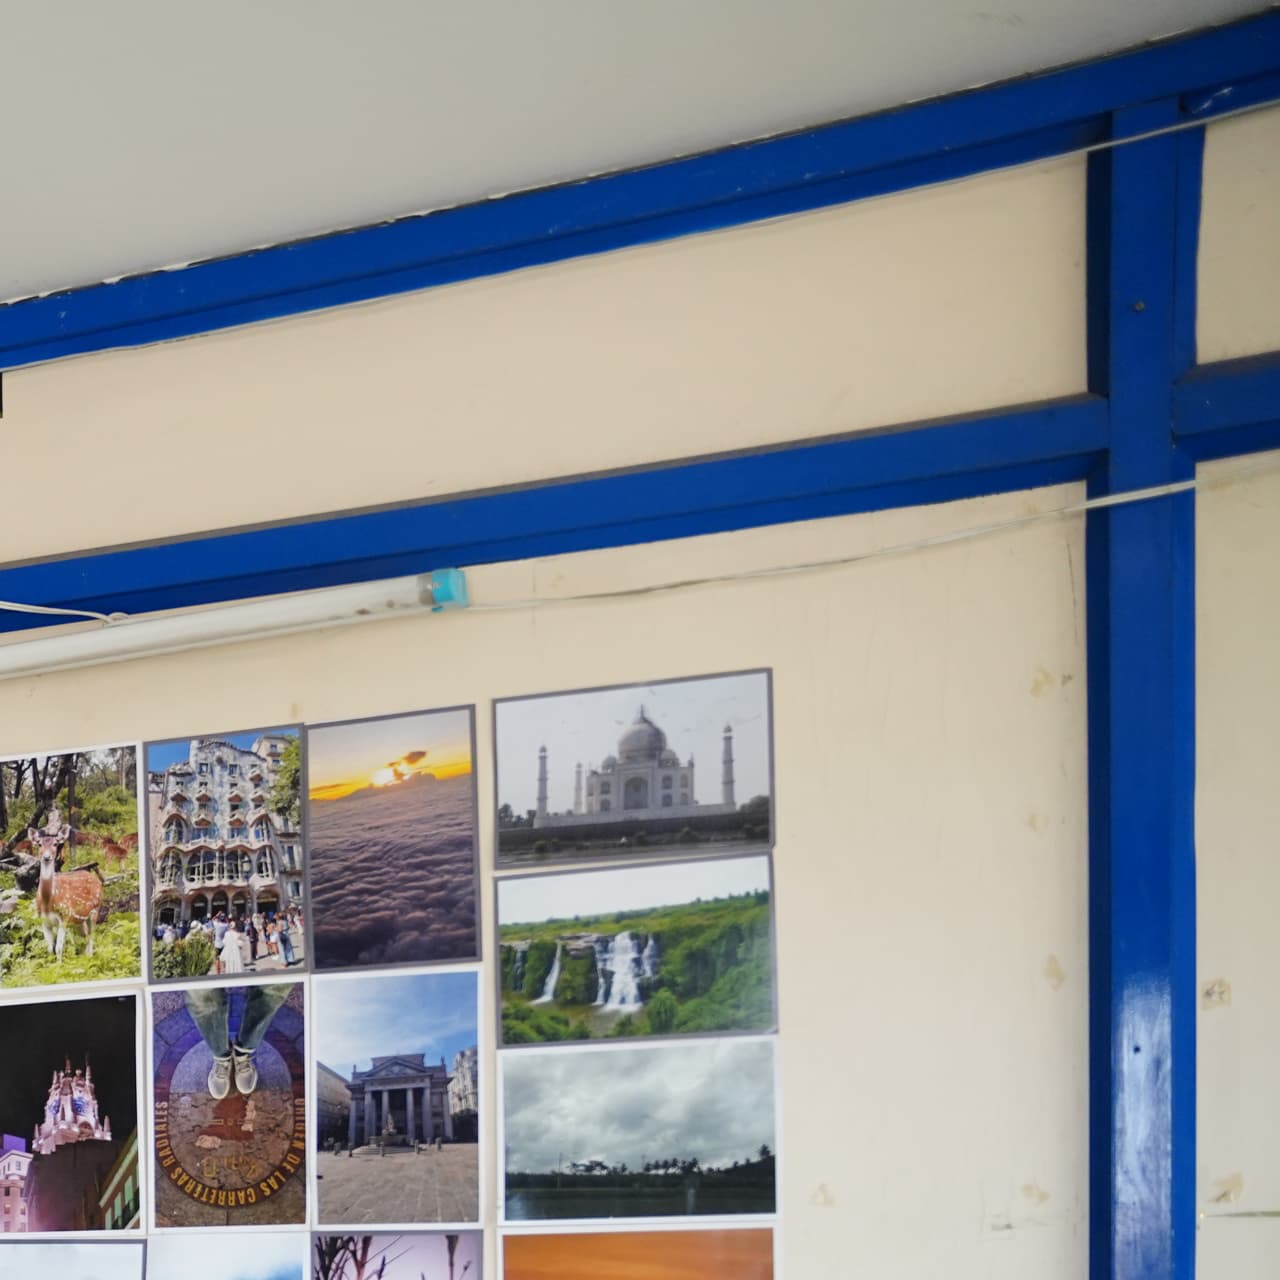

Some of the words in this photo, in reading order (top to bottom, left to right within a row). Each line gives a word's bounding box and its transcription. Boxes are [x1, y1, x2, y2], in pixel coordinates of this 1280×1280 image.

[155, 1101, 176, 1168] RADIALES
[170, 1166, 257, 1206] CARRETERAS
[259, 1171, 287, 1196] LAS
